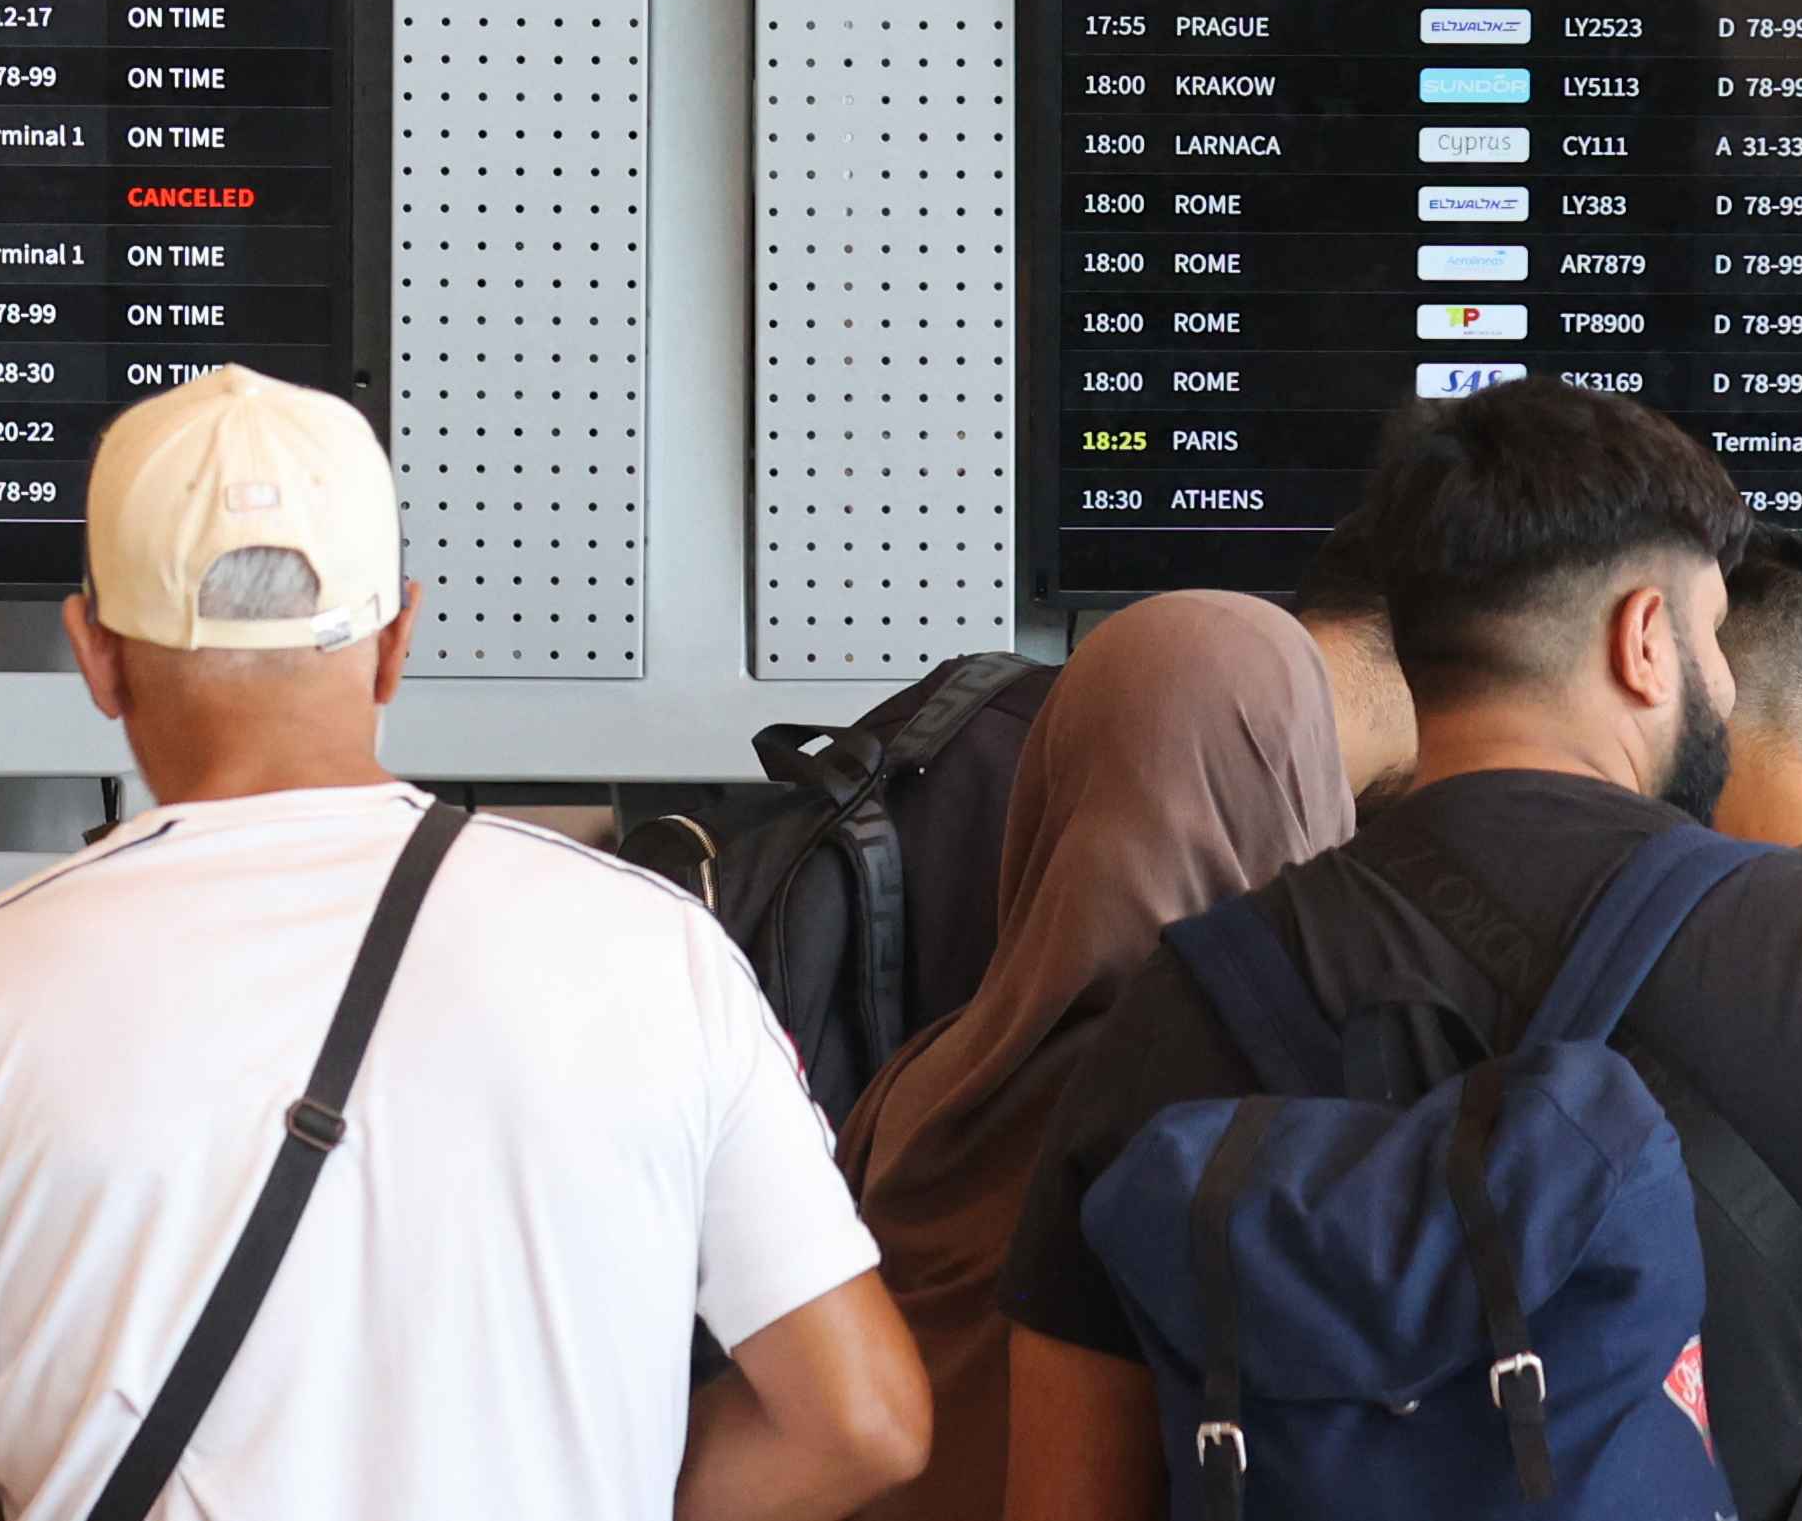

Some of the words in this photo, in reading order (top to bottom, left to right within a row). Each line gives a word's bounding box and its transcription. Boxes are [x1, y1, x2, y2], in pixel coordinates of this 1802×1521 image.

[1084, 134, 1145, 155] 18:00
[1175, 135, 1282, 156] LARNACA
[1437, 133, 1511, 155] Cyprus
[1562, 135, 1629, 157] CY111
[1715, 136, 1733, 157] A
[127, 186, 256, 209] CANCELED
[1082, 431, 1147, 451] 18:25
[1173, 430, 1239, 452] PARIS
